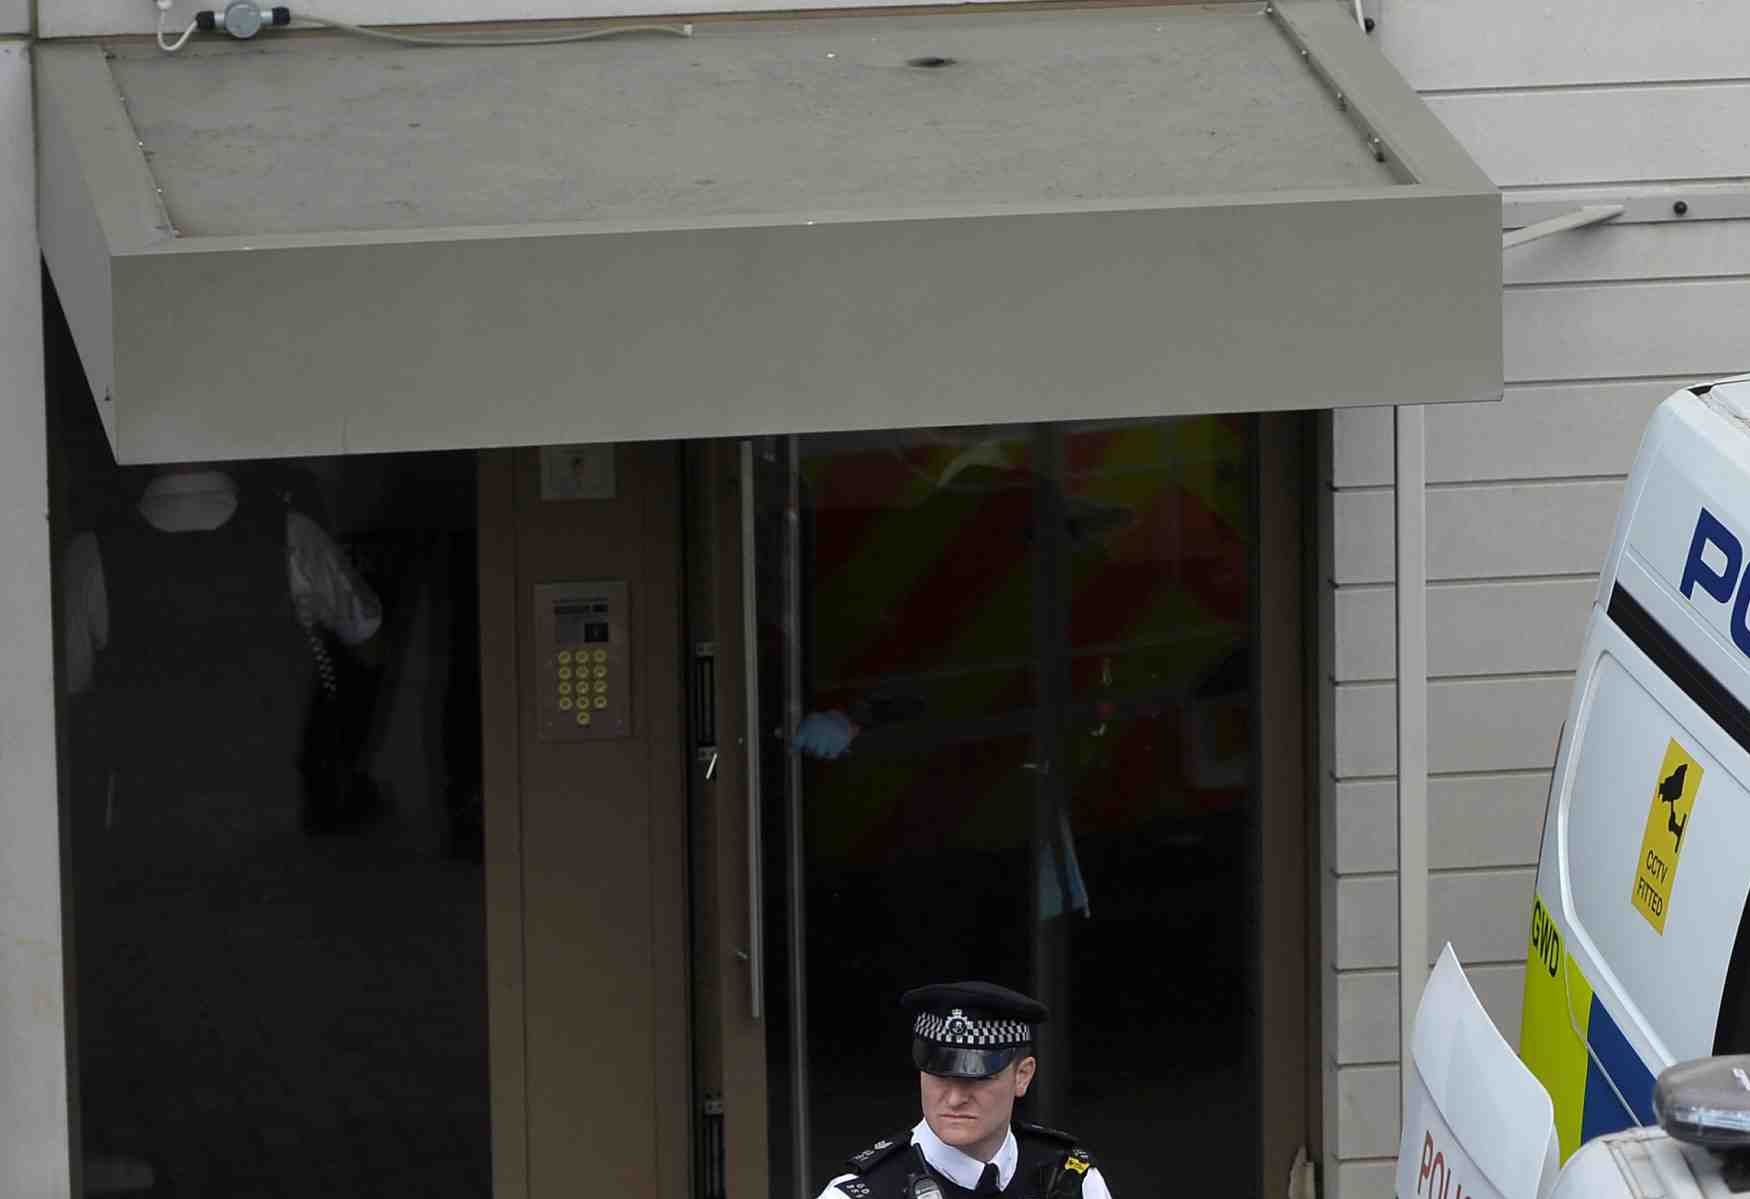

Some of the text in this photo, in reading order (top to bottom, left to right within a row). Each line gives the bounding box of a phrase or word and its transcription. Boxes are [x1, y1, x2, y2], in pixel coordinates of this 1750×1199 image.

[1646, 850, 1669, 884] CCTV
[1637, 877, 1663, 917] FITTED
[1531, 900, 1560, 978] GWD
